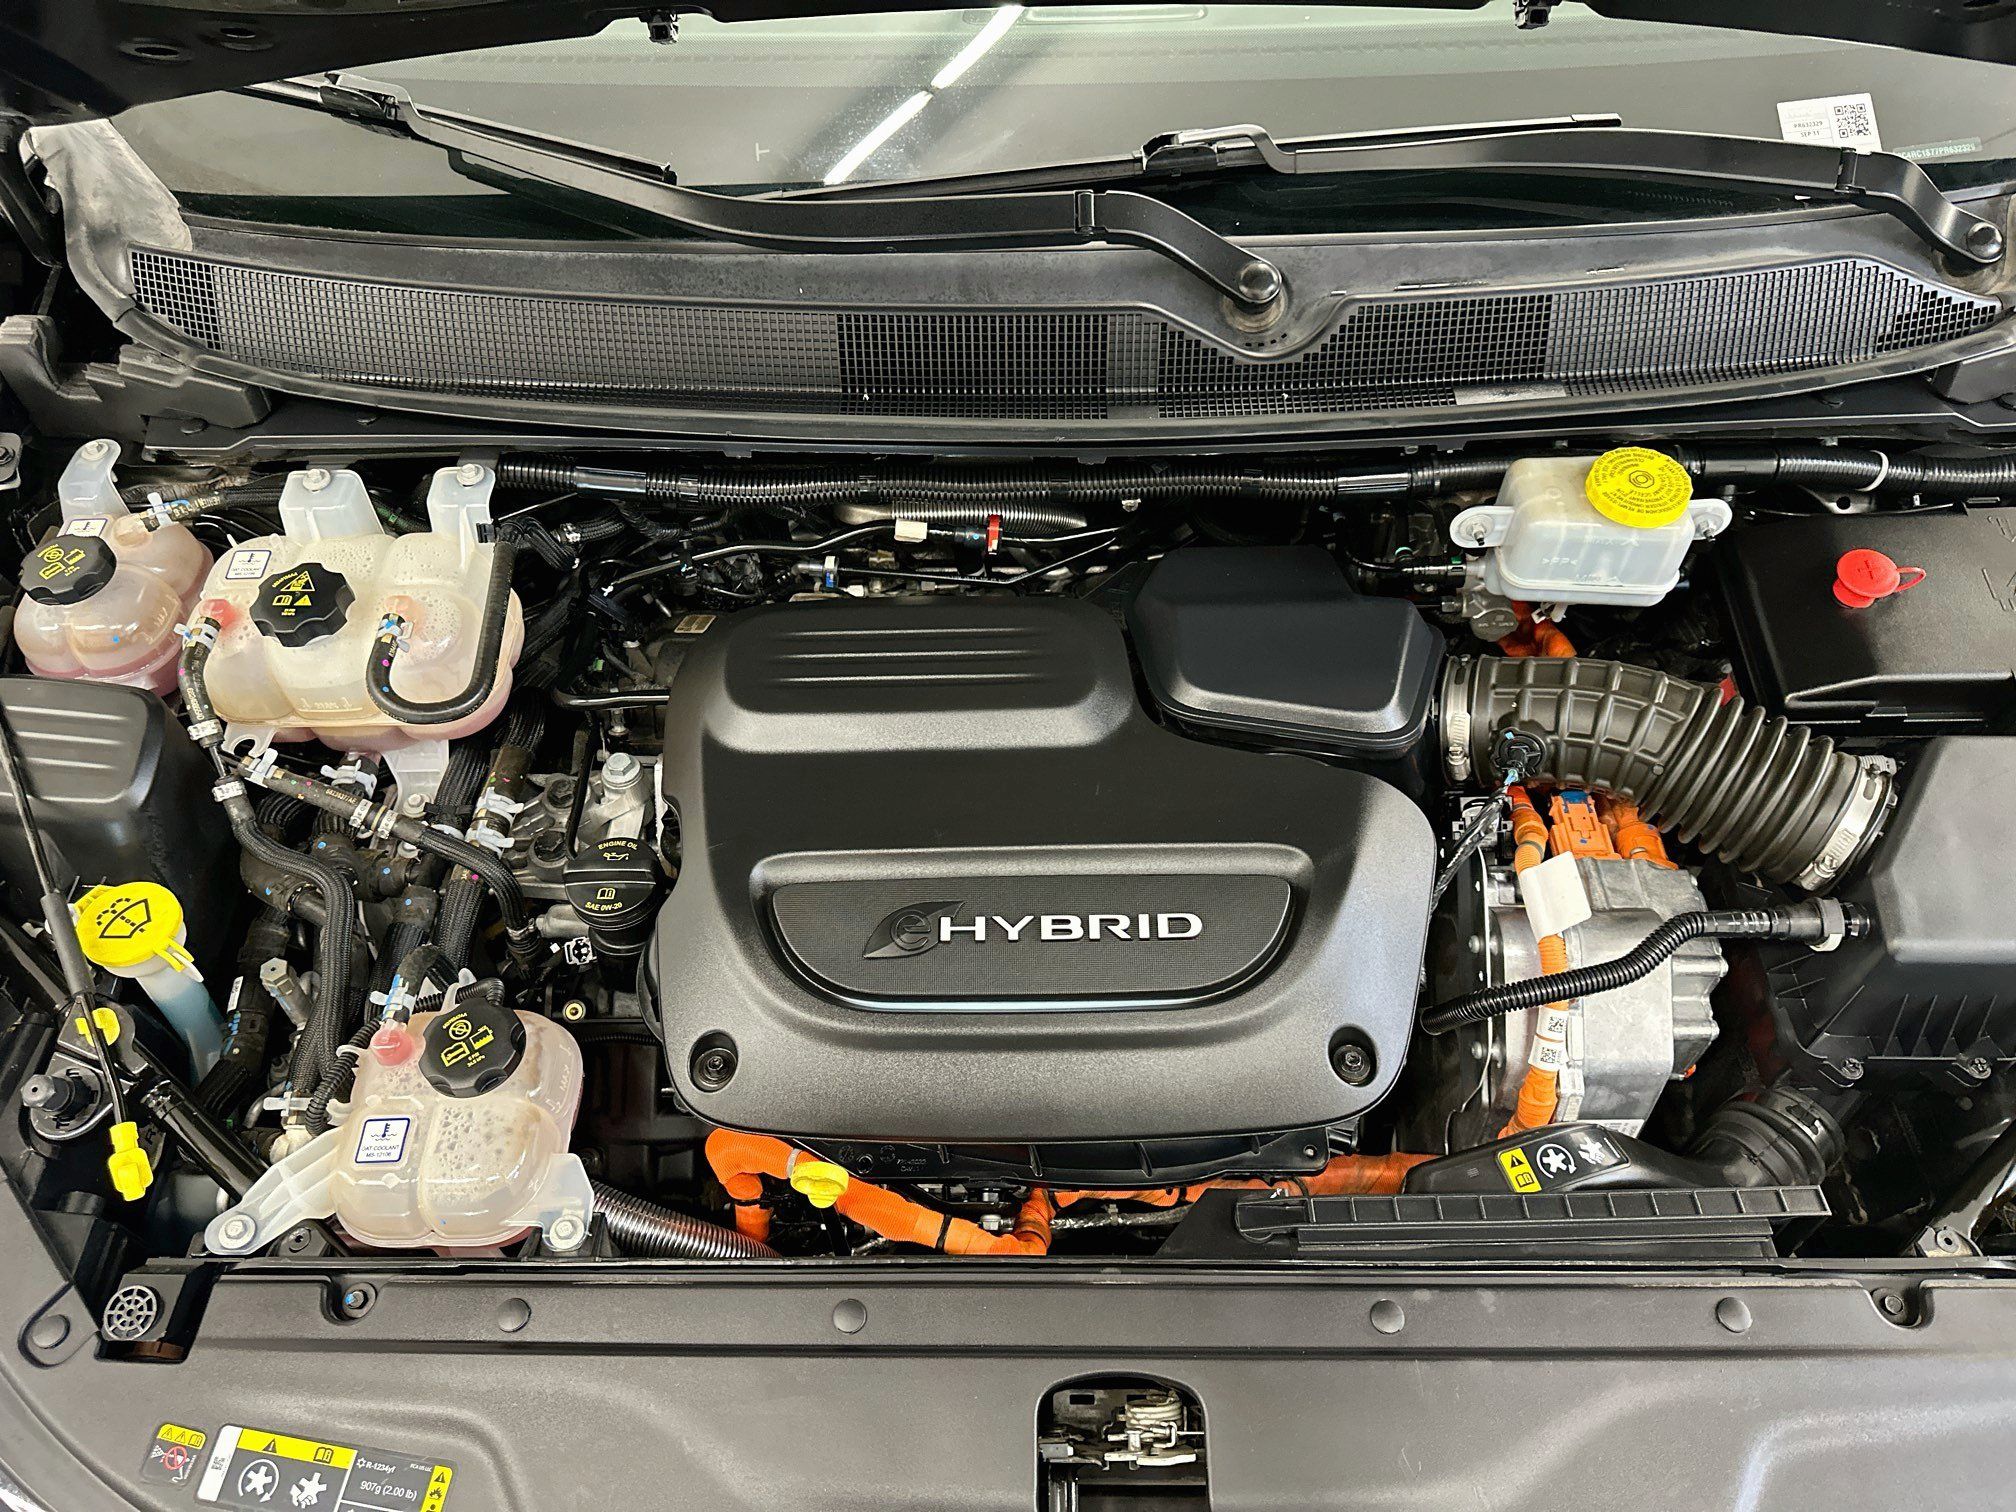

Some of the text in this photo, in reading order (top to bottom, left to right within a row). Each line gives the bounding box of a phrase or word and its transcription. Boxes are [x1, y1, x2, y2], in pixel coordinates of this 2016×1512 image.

[1896, 143, 1976, 159] C4RC1S77PR632329
[598, 840, 639, 851] ENGINE OIL
[585, 901, 623, 911] SAE 0W-20
[366, 1460, 397, 1474] R-1234yf
[360, 1480, 418, 1502] 907g (2.00 lb)
